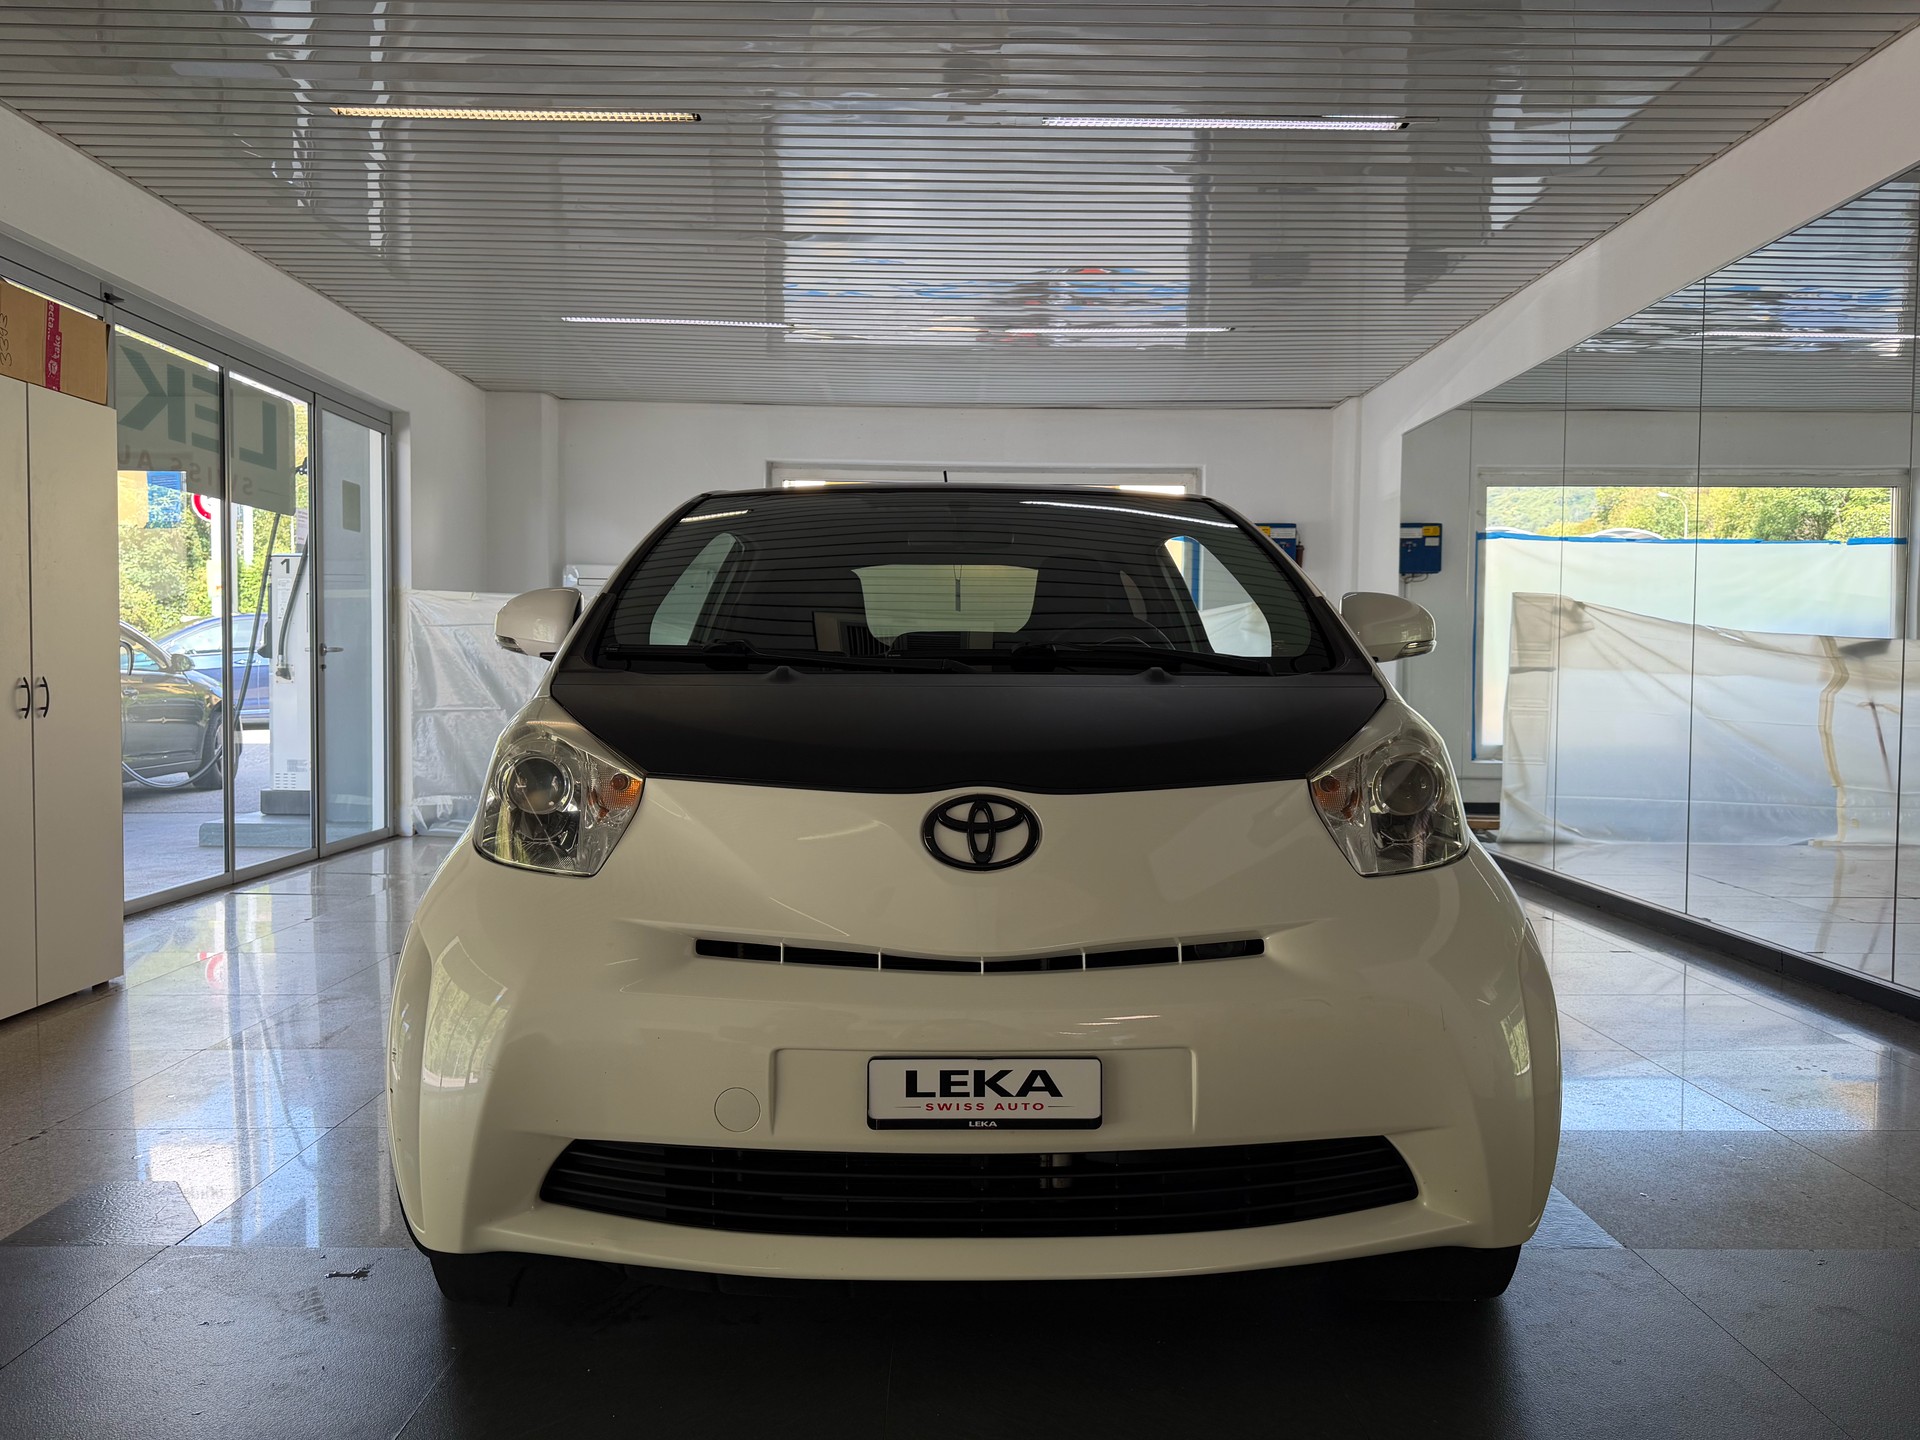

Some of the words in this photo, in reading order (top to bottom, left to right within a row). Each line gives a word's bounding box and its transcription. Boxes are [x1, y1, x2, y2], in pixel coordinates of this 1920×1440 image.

[281, 558, 290, 574] 1
[905, 1069, 1063, 1098] LEKA
[925, 1102, 985, 1112] SWISS
[994, 1102, 1044, 1111] AUTO
[968, 1120, 998, 1128] LEKA
